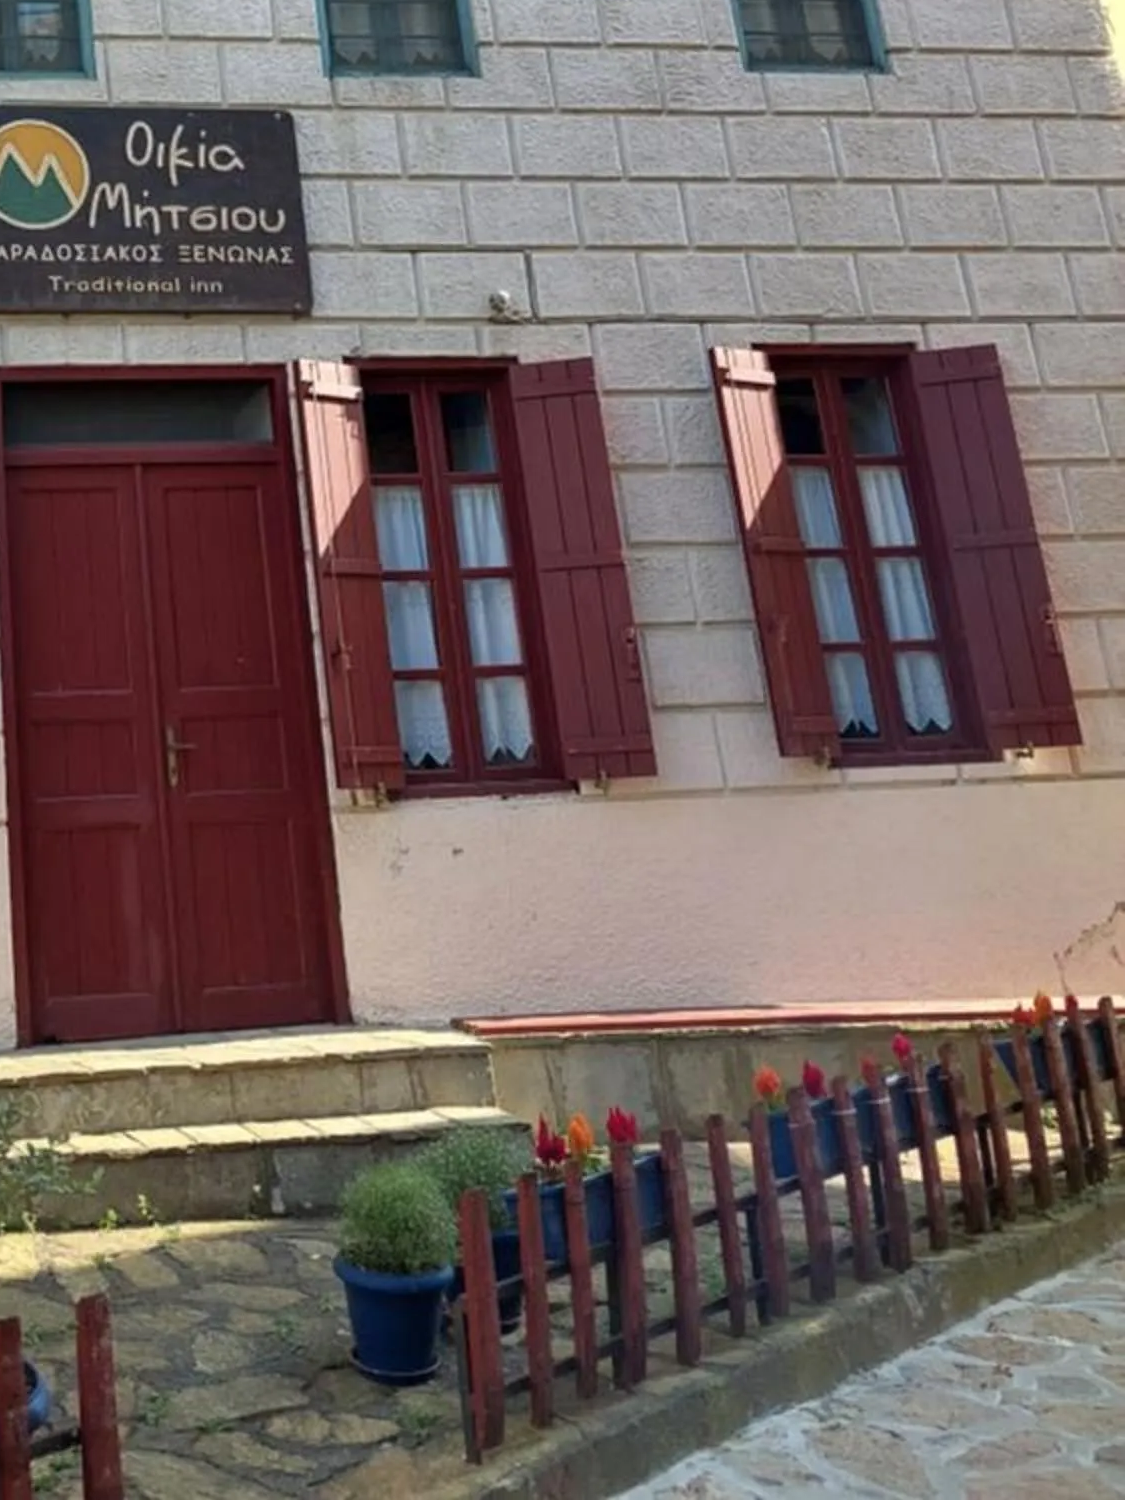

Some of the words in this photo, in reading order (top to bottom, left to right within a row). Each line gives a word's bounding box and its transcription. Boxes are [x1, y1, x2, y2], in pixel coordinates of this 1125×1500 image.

[178, 245, 294, 264] ΞΕΝΩΝΑΣ
[48, 275, 180, 293] Traditional
[190, 277, 223, 293] inn
